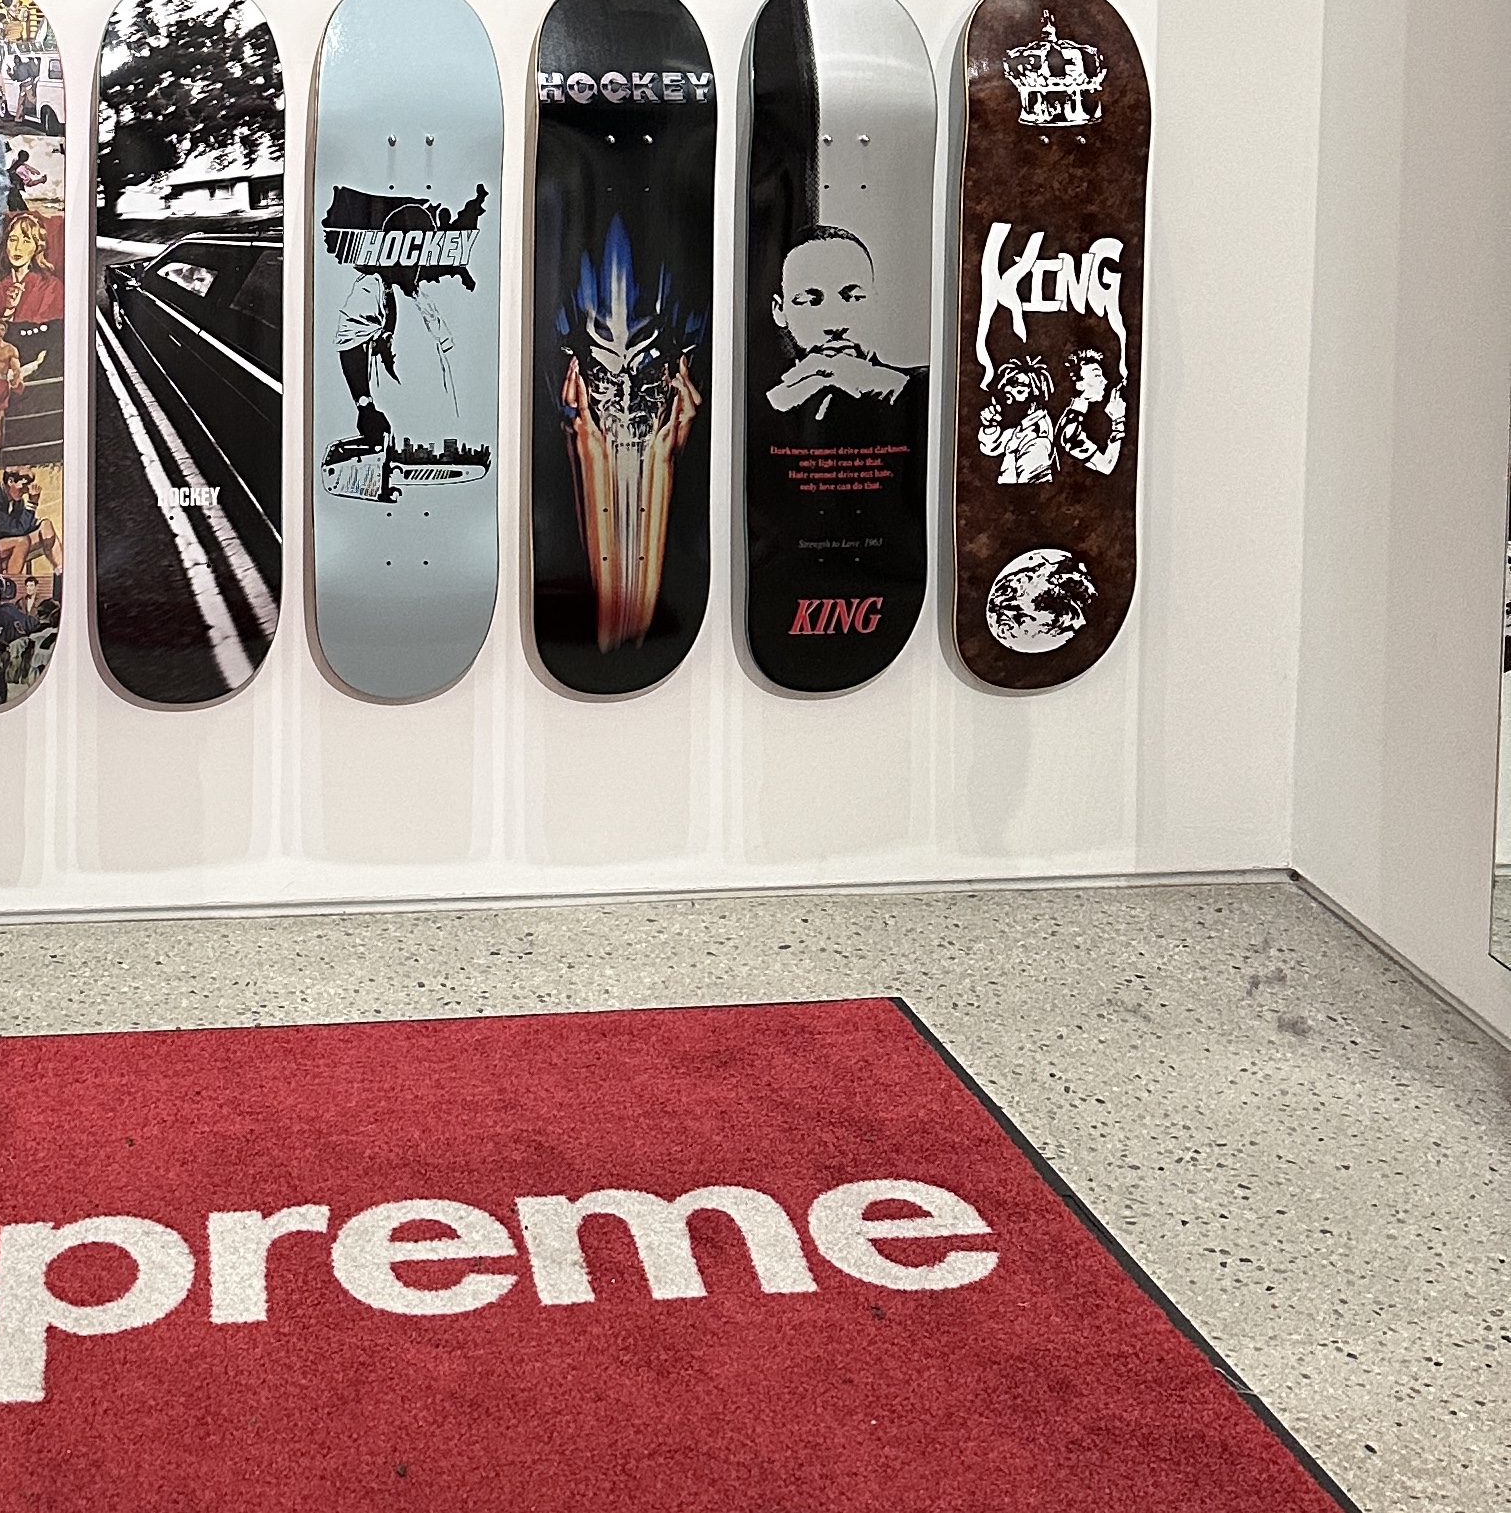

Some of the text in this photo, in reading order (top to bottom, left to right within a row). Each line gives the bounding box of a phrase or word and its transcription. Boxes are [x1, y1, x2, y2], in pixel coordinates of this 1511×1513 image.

[537, 71, 714, 104] HOCKEY
[355, 229, 481, 267] HOCKEY
[788, 470, 808, 479] Hate
[818, 458, 836, 468] light
[787, 596, 884, 635] KING
